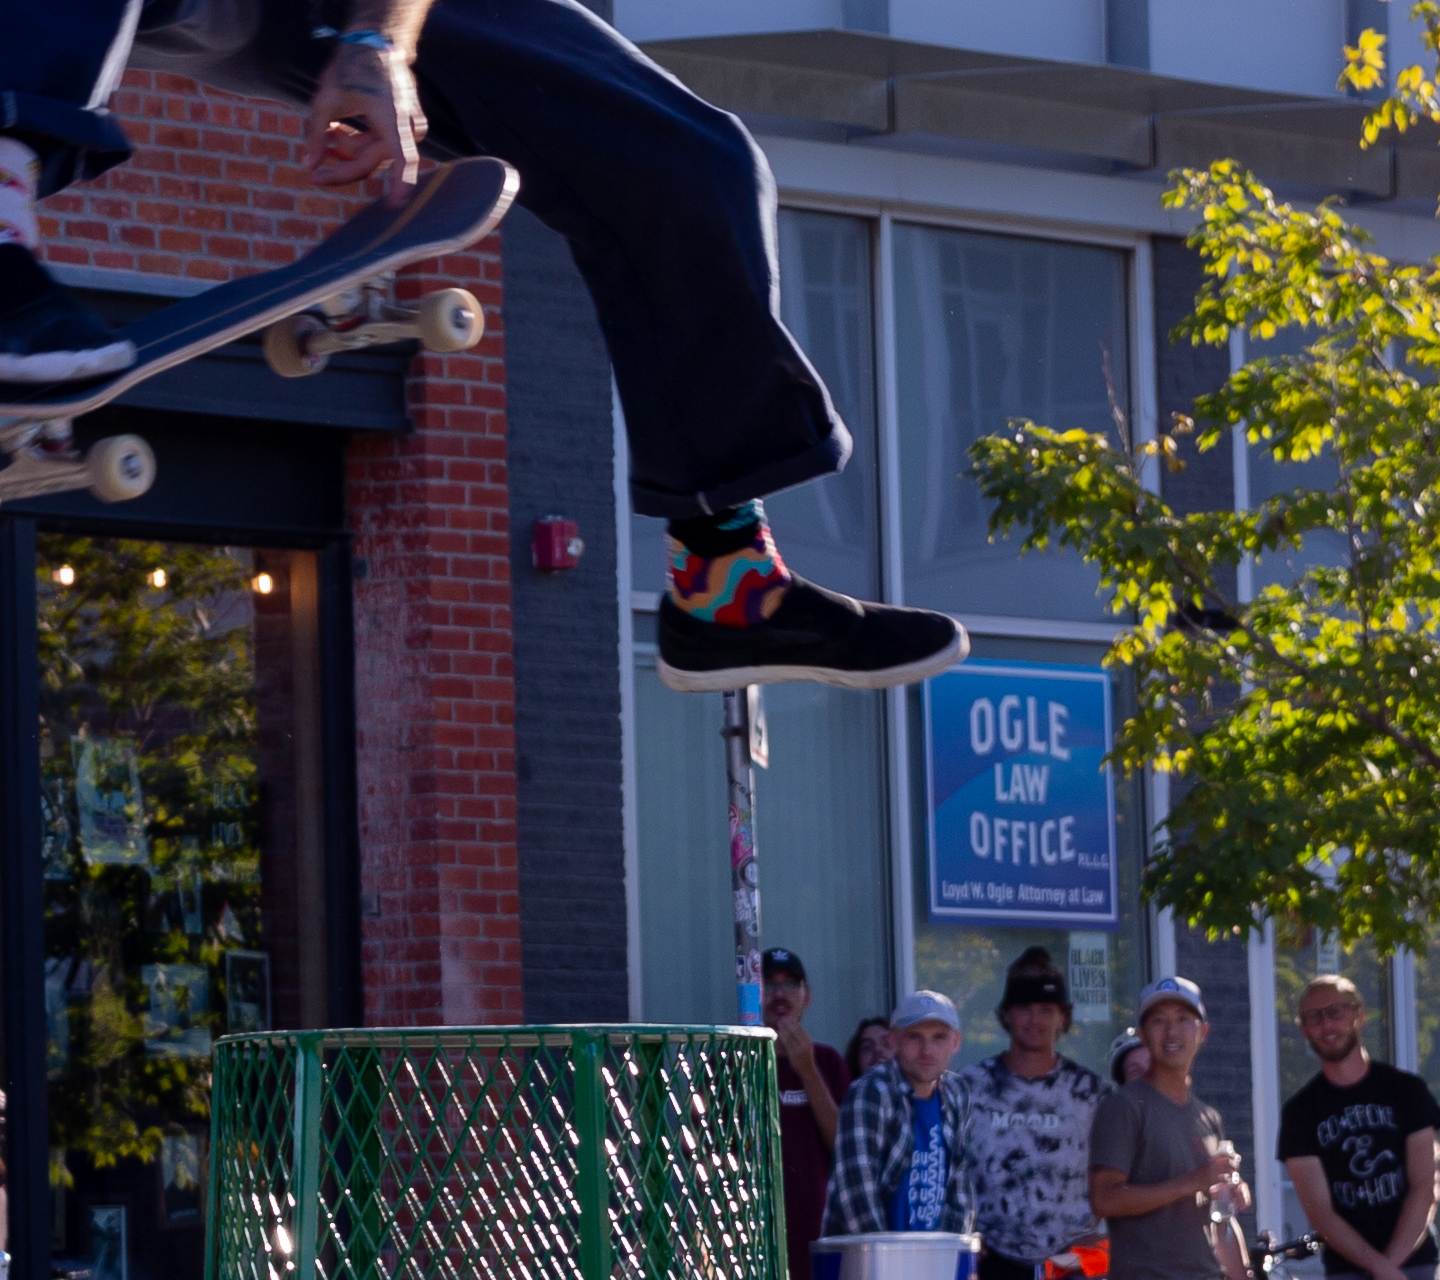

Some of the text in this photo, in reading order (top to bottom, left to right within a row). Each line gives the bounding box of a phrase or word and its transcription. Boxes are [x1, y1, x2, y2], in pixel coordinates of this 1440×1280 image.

[970, 694, 1070, 761] OGLE
[994, 763, 1050, 803] LAW
[970, 810, 1076, 866] OFFICE
[942, 879, 1104, 905] Loyd W. Ogle Attorney at Law
[1071, 967, 1106, 988] LIVES
